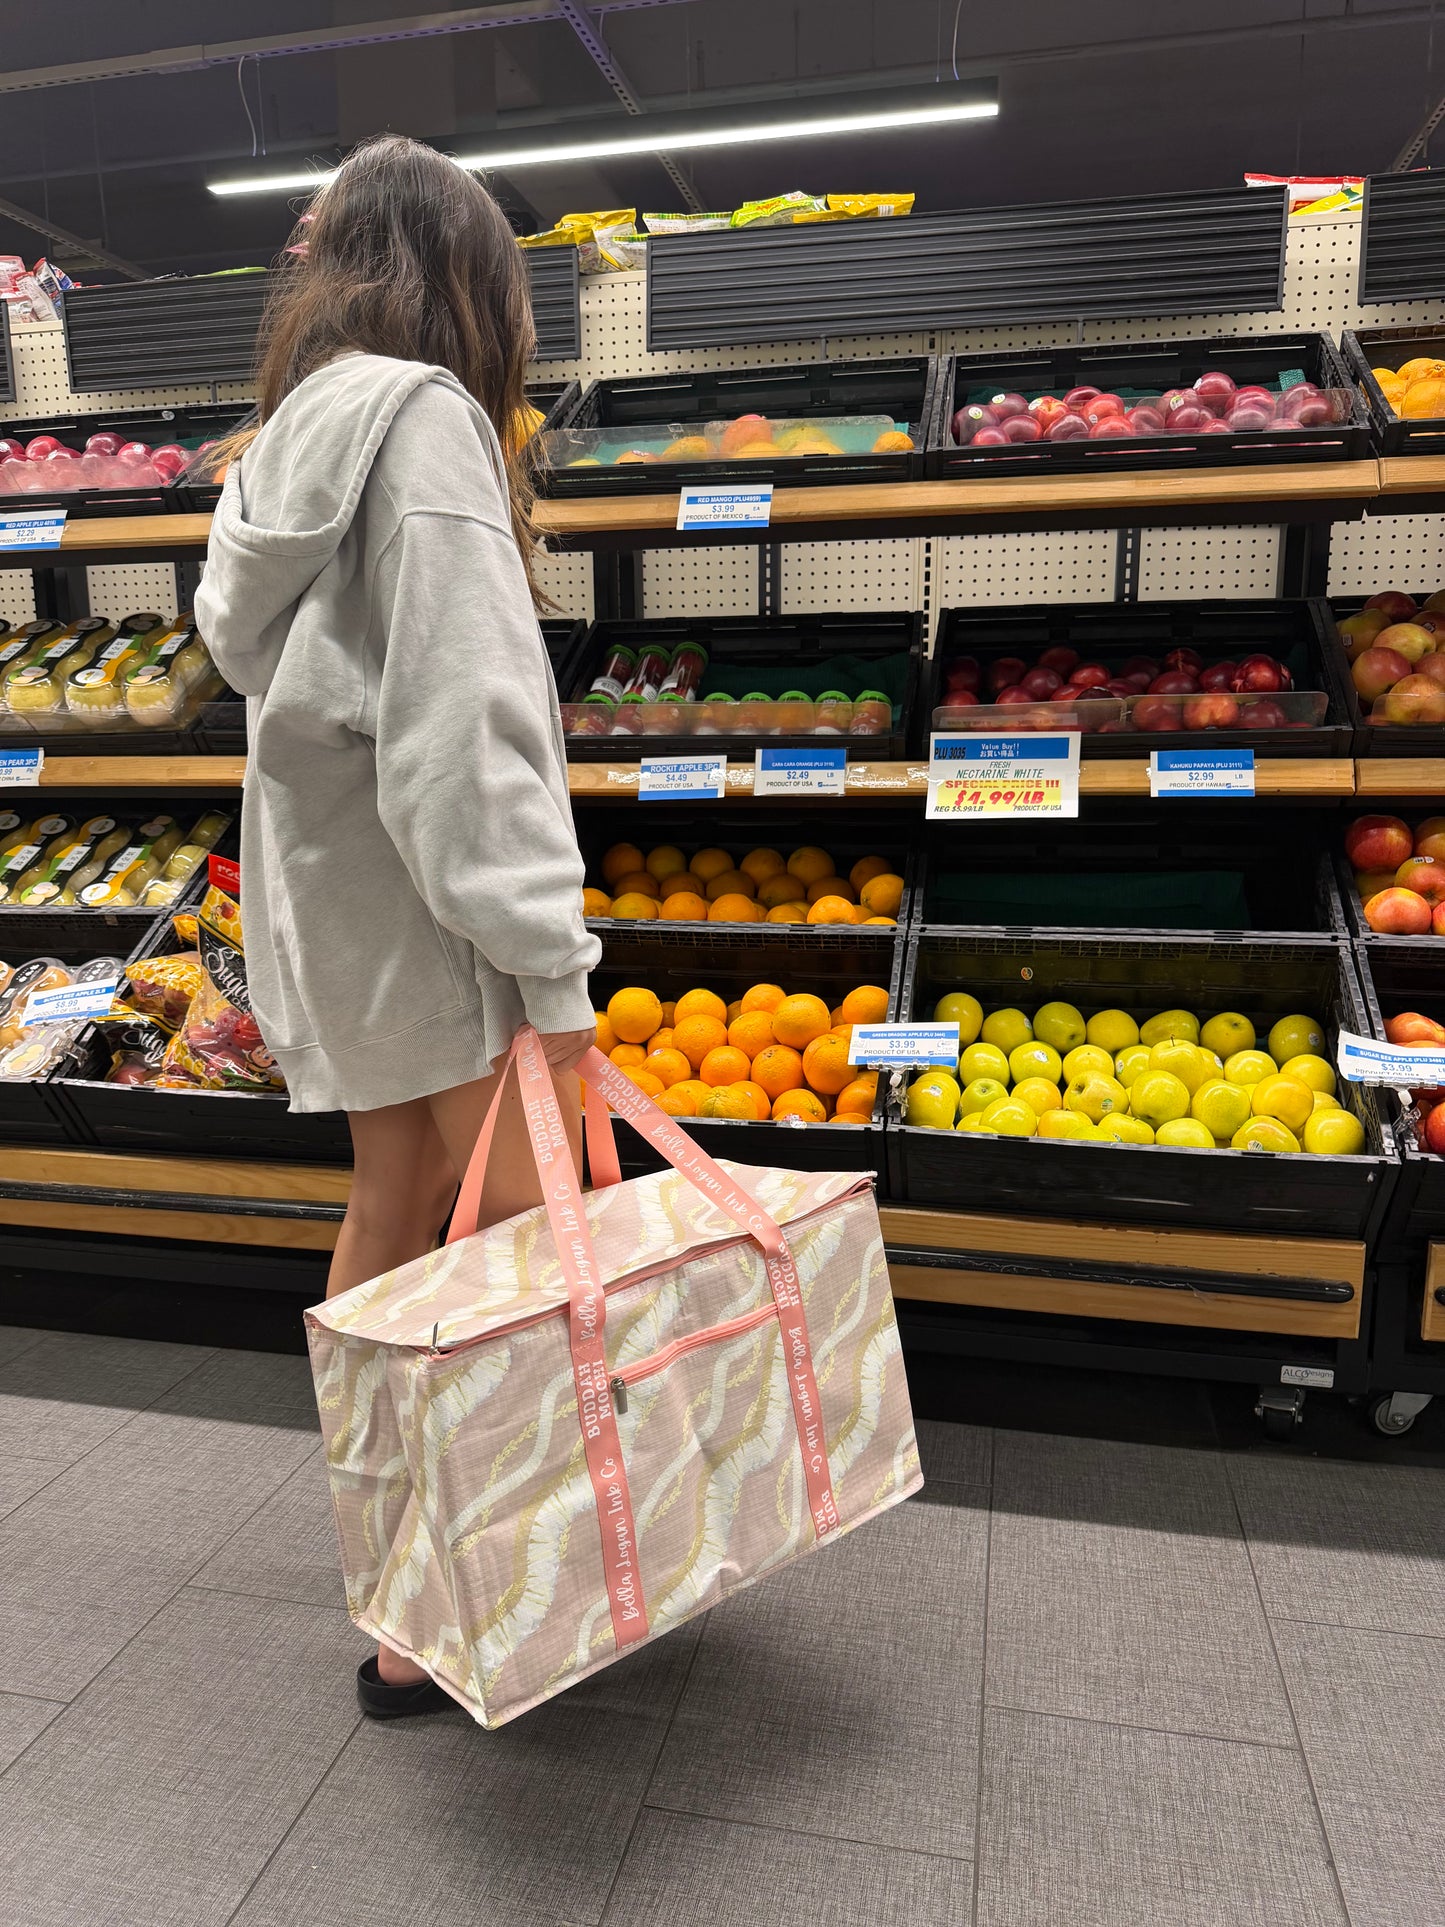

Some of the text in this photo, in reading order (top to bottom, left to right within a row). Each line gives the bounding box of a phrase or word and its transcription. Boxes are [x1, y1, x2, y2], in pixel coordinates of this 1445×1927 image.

[712, 504, 735, 513] $3.99
[16, 529, 35, 537] $2.29
[934, 747, 966, 760] PLU 3035
[650, 763, 719, 773] ROCKIT APPLE 3PC
[665, 774, 687, 782] $4.49
[786, 771, 809, 780] $2.49
[956, 768, 1044, 779] NECTARINE WHITE
[1188, 772, 1214, 781] $2.99
[1045, 780, 1060, 788] !!!
[955, 790, 1045, 806] $4.99/LB
[75, 990, 94, 998] APPLE
[889, 1040, 916, 1048] $3.99
[1359, 1051, 1380, 1059] SUGAR
[1381, 1063, 1413, 1072] $3.99
[599, 1062, 651, 1114] BUDDAH
[596, 1080, 639, 1122] MOCHI
[527, 1100, 554, 1164] BUDDAH
[543, 1095, 566, 1148] MOCHI
[651, 1124, 765, 1232] Bella Logan Ink Co
[554, 1183, 598, 1342] Bella Logan Ink Co
[768, 1257, 790, 1310] MOCHI
[778, 1241, 800, 1307] BUDDAH
[593, 1359, 612, 1420] MOCHI
[788, 1325, 824, 1475] Bella Logan Ink Co
[577, 1361, 601, 1440] BUDDAH
[821, 1489, 838, 1529] BUD
[814, 1508, 828, 1534] MO
[600, 1457, 640, 1622] Bella Logan Ink Co
